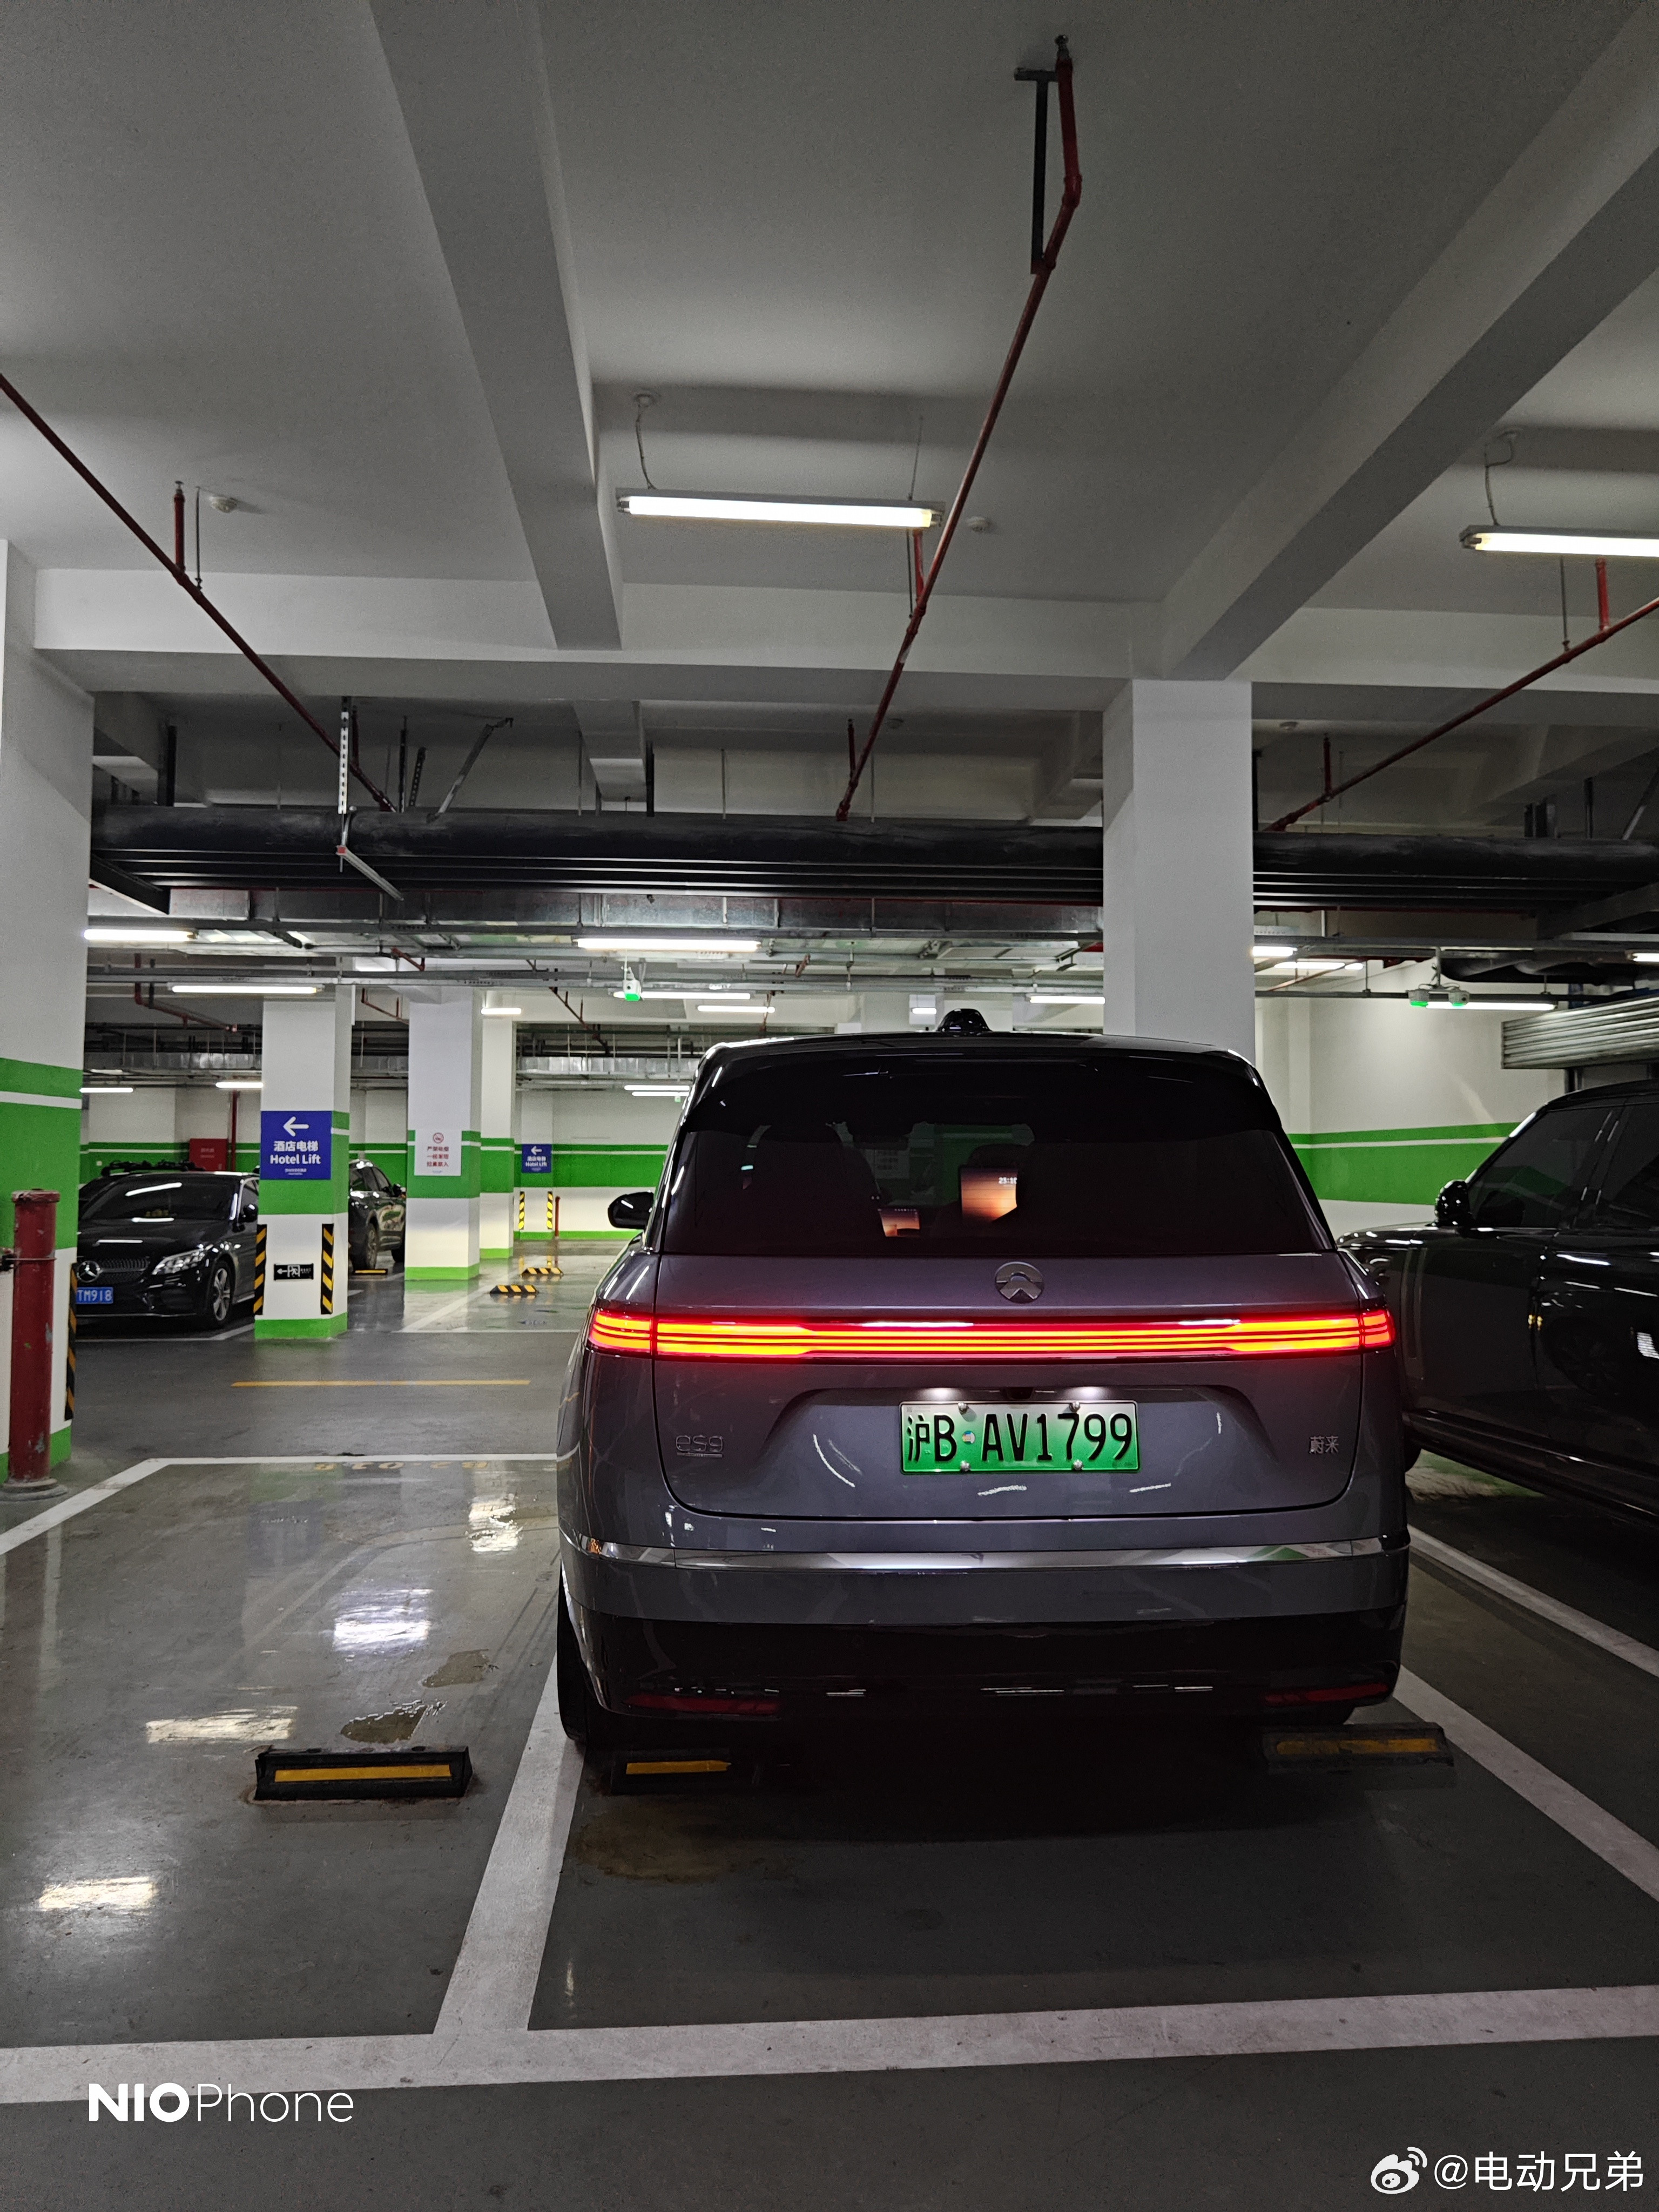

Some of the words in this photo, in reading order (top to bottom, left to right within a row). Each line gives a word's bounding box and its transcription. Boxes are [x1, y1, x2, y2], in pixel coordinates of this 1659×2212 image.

[274, 1140, 318, 1151] 酒店电梯
[270, 1154, 300, 1164] Hotel
[302, 1154, 321, 1164] Lift
[1309, 1435, 1339, 1454] 蔚来
